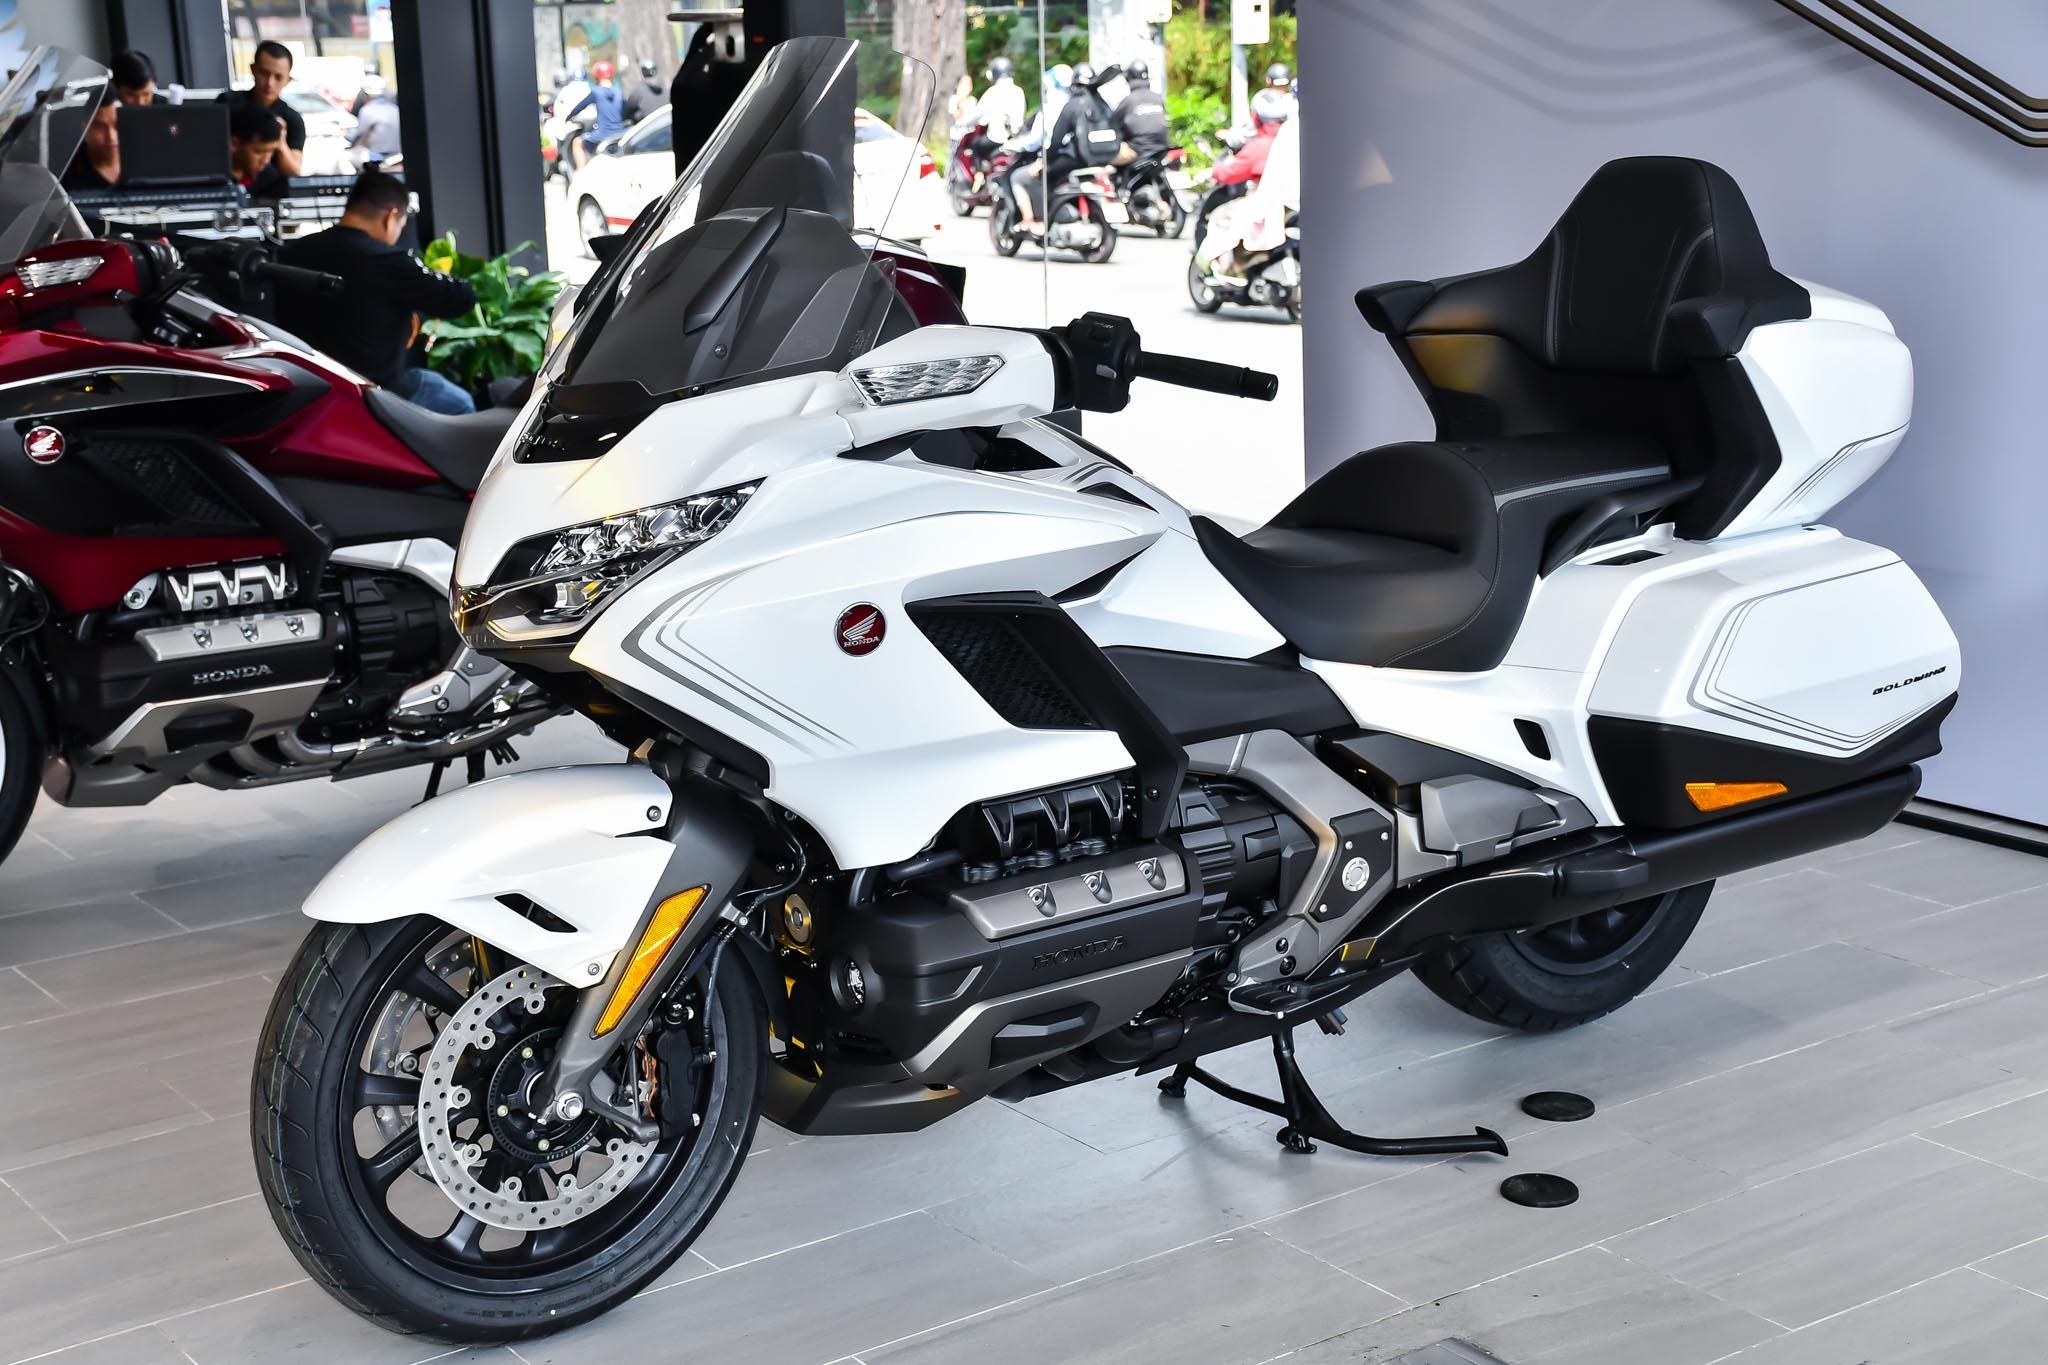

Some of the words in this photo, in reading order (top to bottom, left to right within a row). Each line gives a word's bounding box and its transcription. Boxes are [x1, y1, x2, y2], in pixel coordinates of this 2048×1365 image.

[843, 636, 880, 648] HONDA
[192, 664, 273, 685] HONDA
[1032, 935, 1126, 971] HONDA
